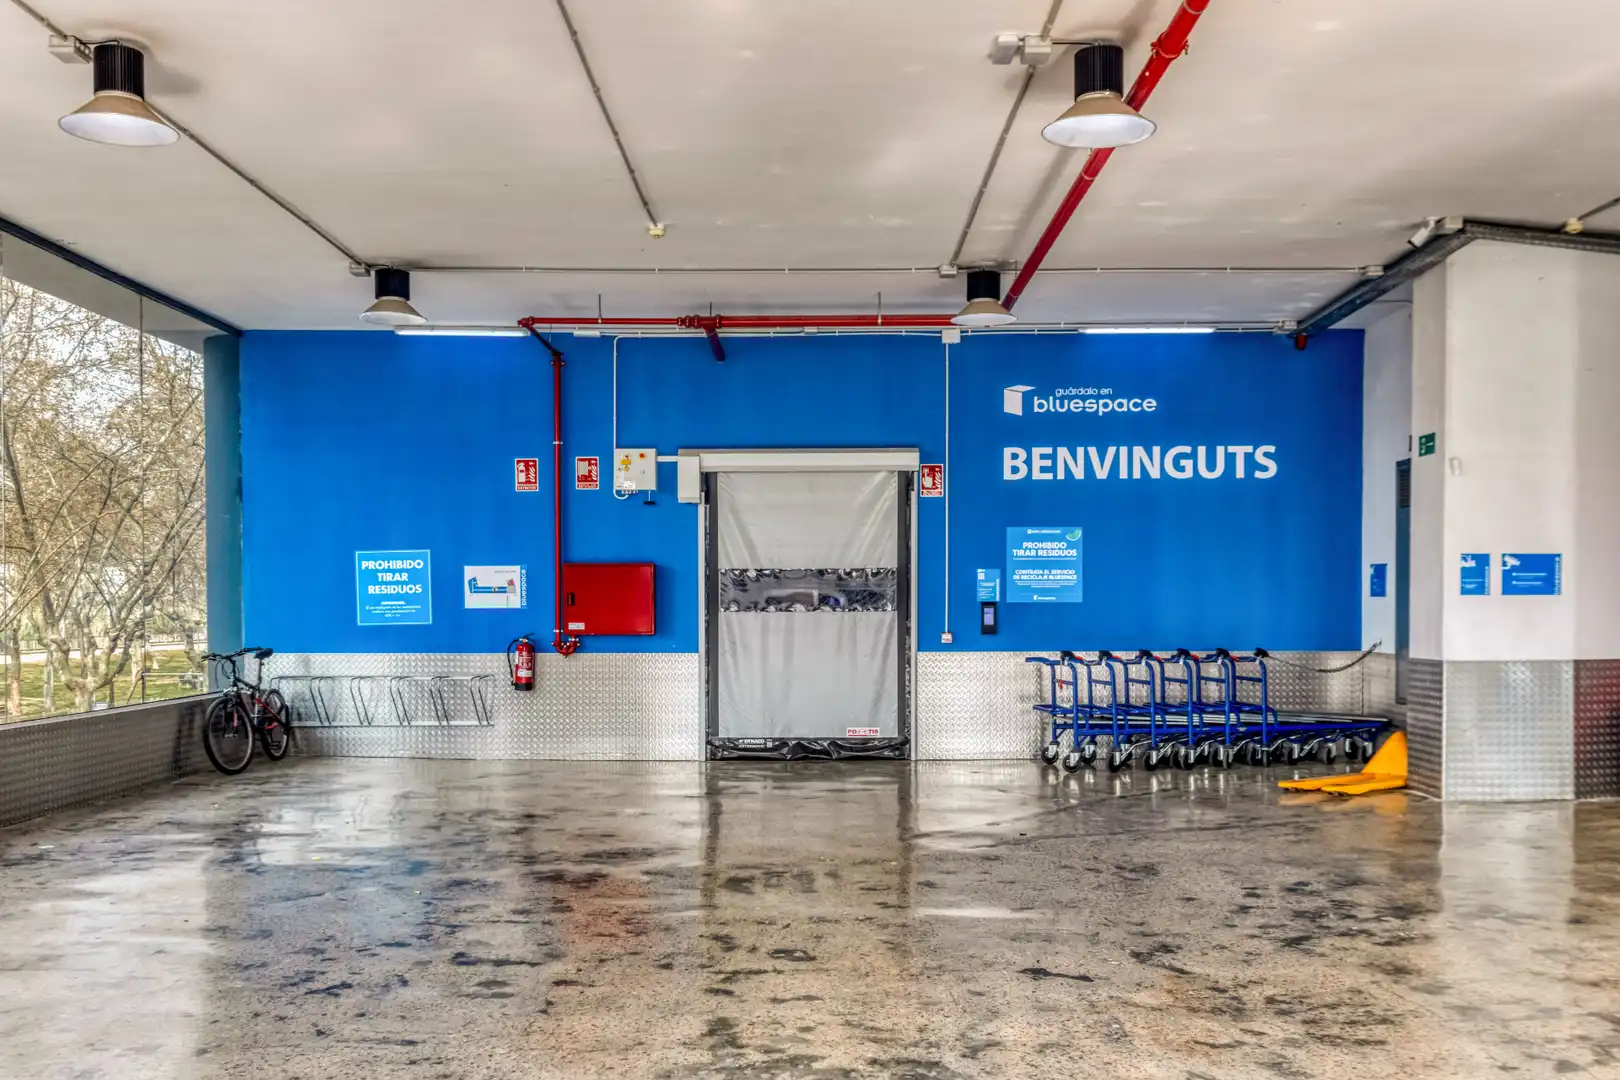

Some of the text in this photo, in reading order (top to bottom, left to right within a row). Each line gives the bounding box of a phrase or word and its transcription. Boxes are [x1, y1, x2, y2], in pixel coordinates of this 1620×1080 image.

[1055, 387, 1098, 397] guárdalo
[1033, 396, 1157, 416] bluespace
[1003, 445, 1278, 480] BENVINGUTS
[1022, 541, 1067, 549] PROHIBIDO
[1012, 549, 1077, 557] TIRAR RESIDUOS
[361, 559, 424, 570] PROHIBIDO
[377, 572, 409, 582] TIRAR
[367, 584, 423, 595] RESIDUOS
